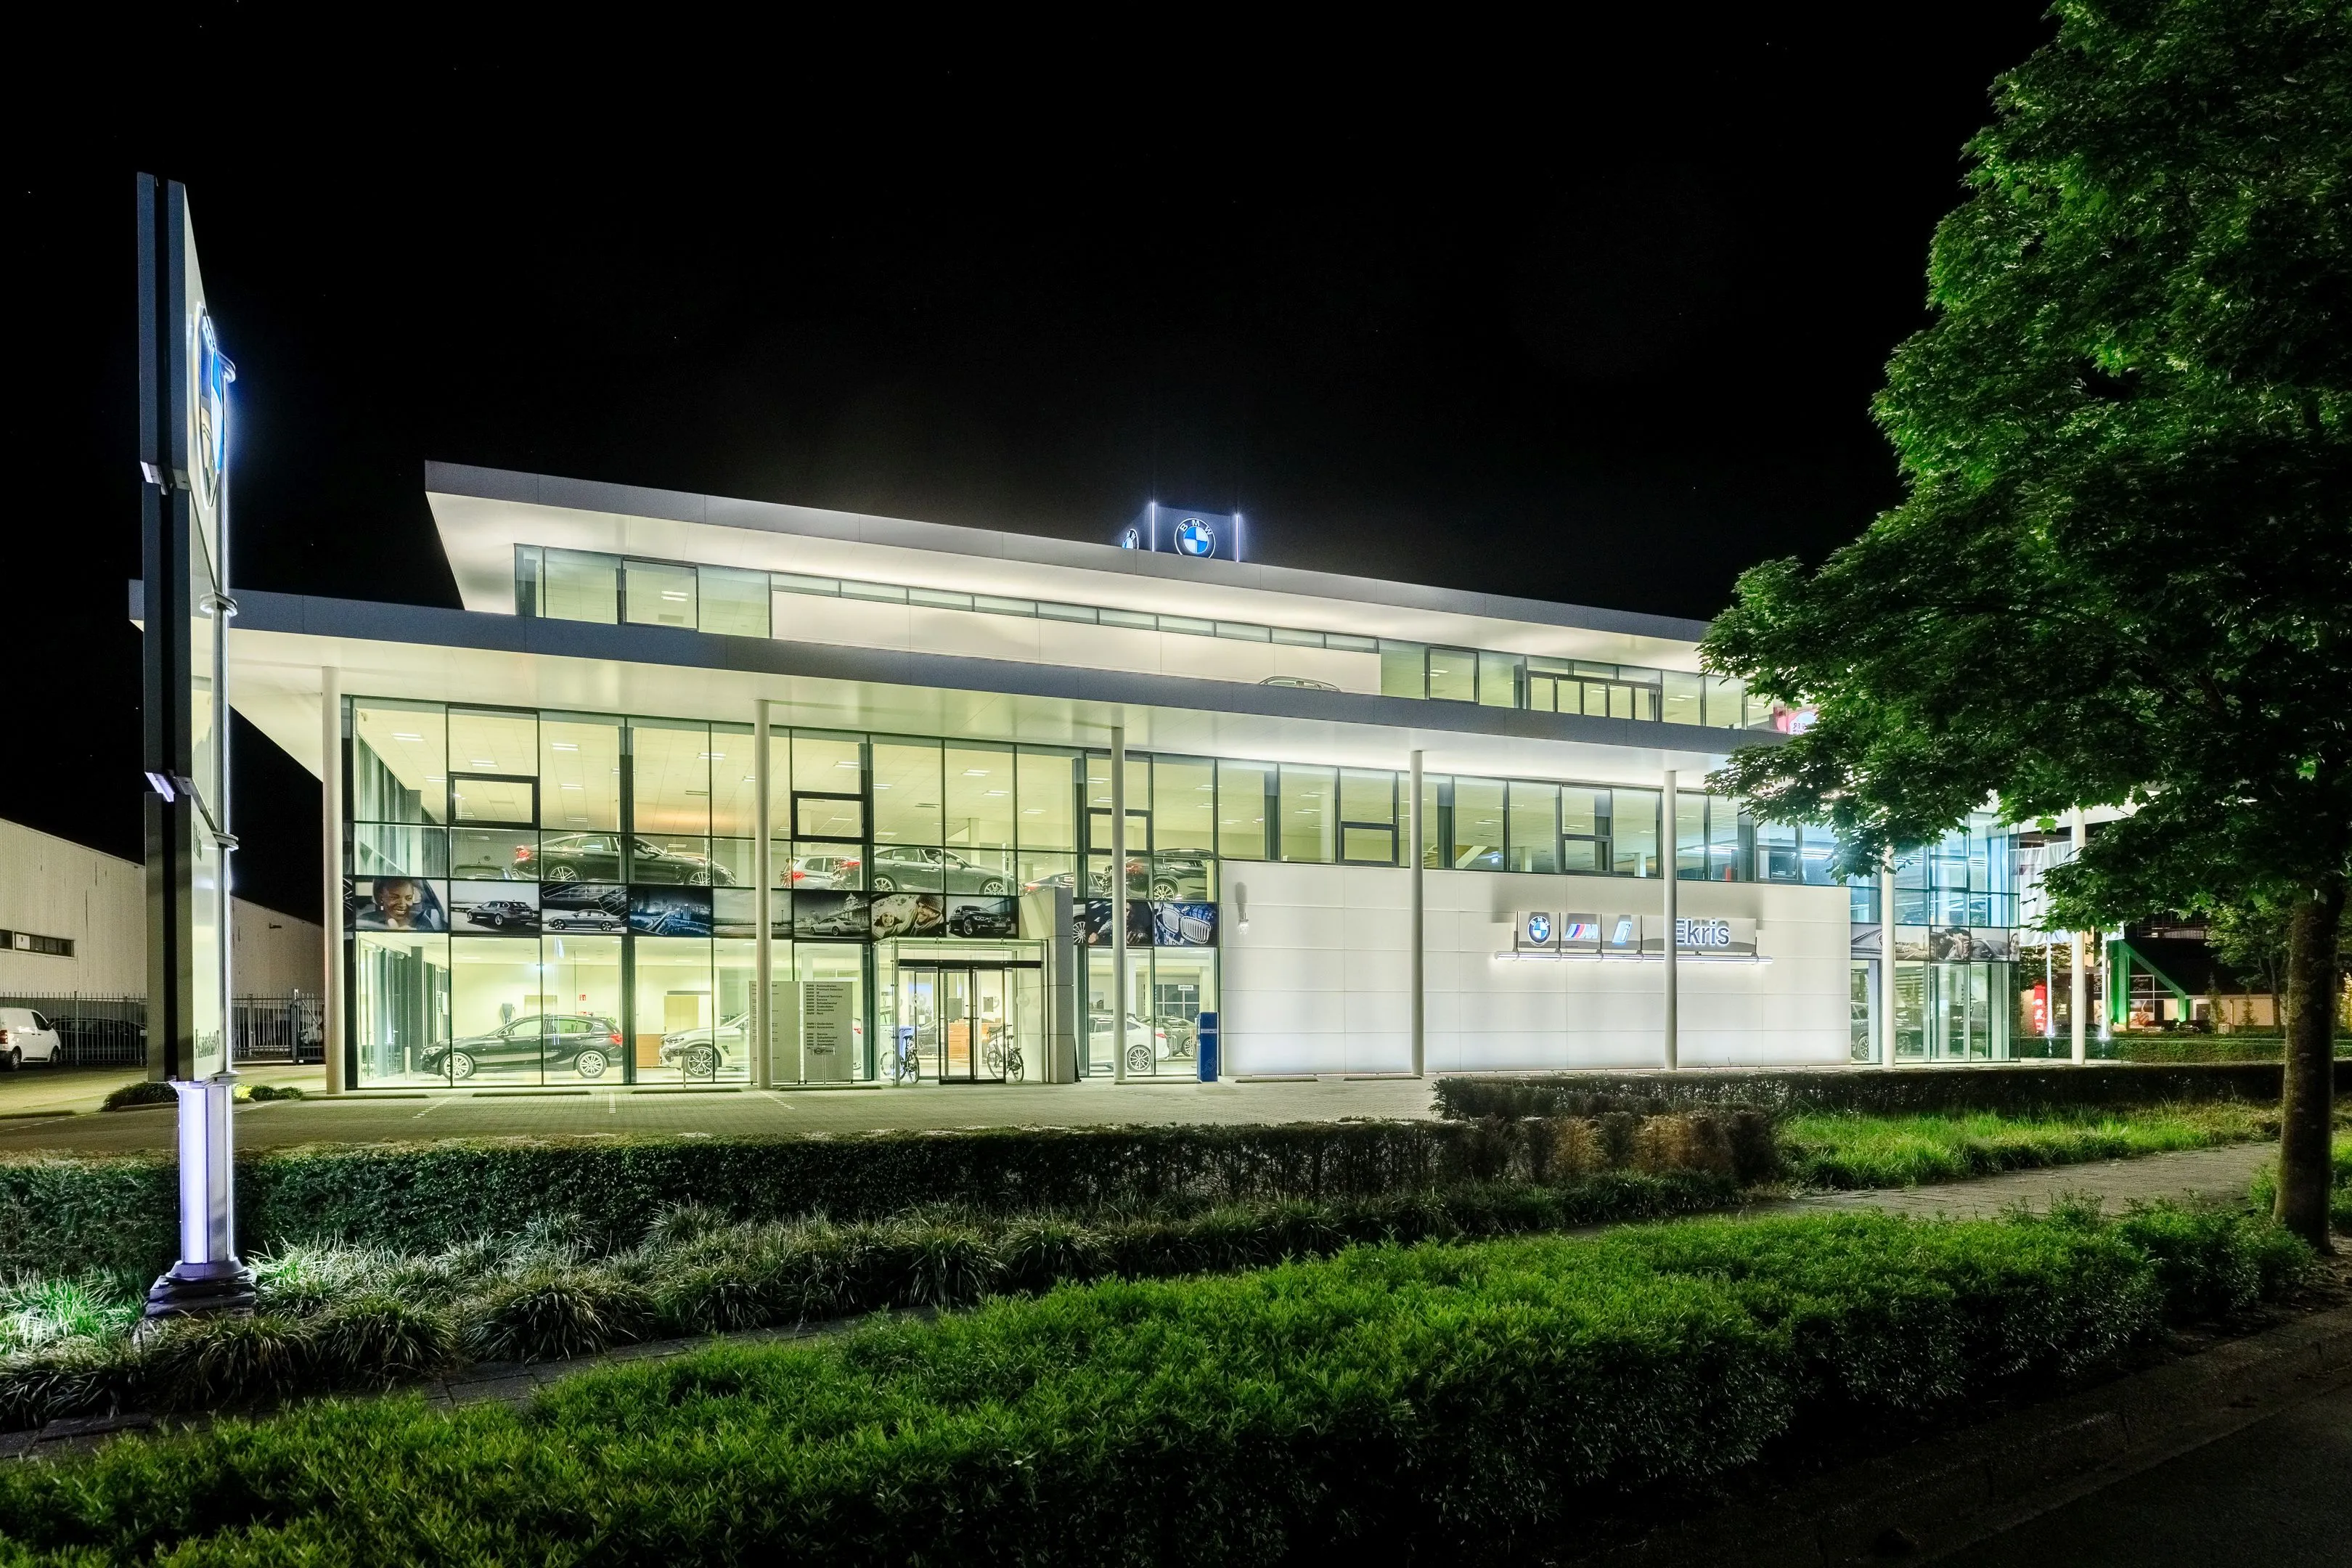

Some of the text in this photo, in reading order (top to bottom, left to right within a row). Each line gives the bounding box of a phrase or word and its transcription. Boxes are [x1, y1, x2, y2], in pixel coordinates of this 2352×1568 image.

[1179, 519, 1212, 536] BMW
[1530, 916, 1550, 927] BMW
[1676, 920, 1729, 944] Ekris
